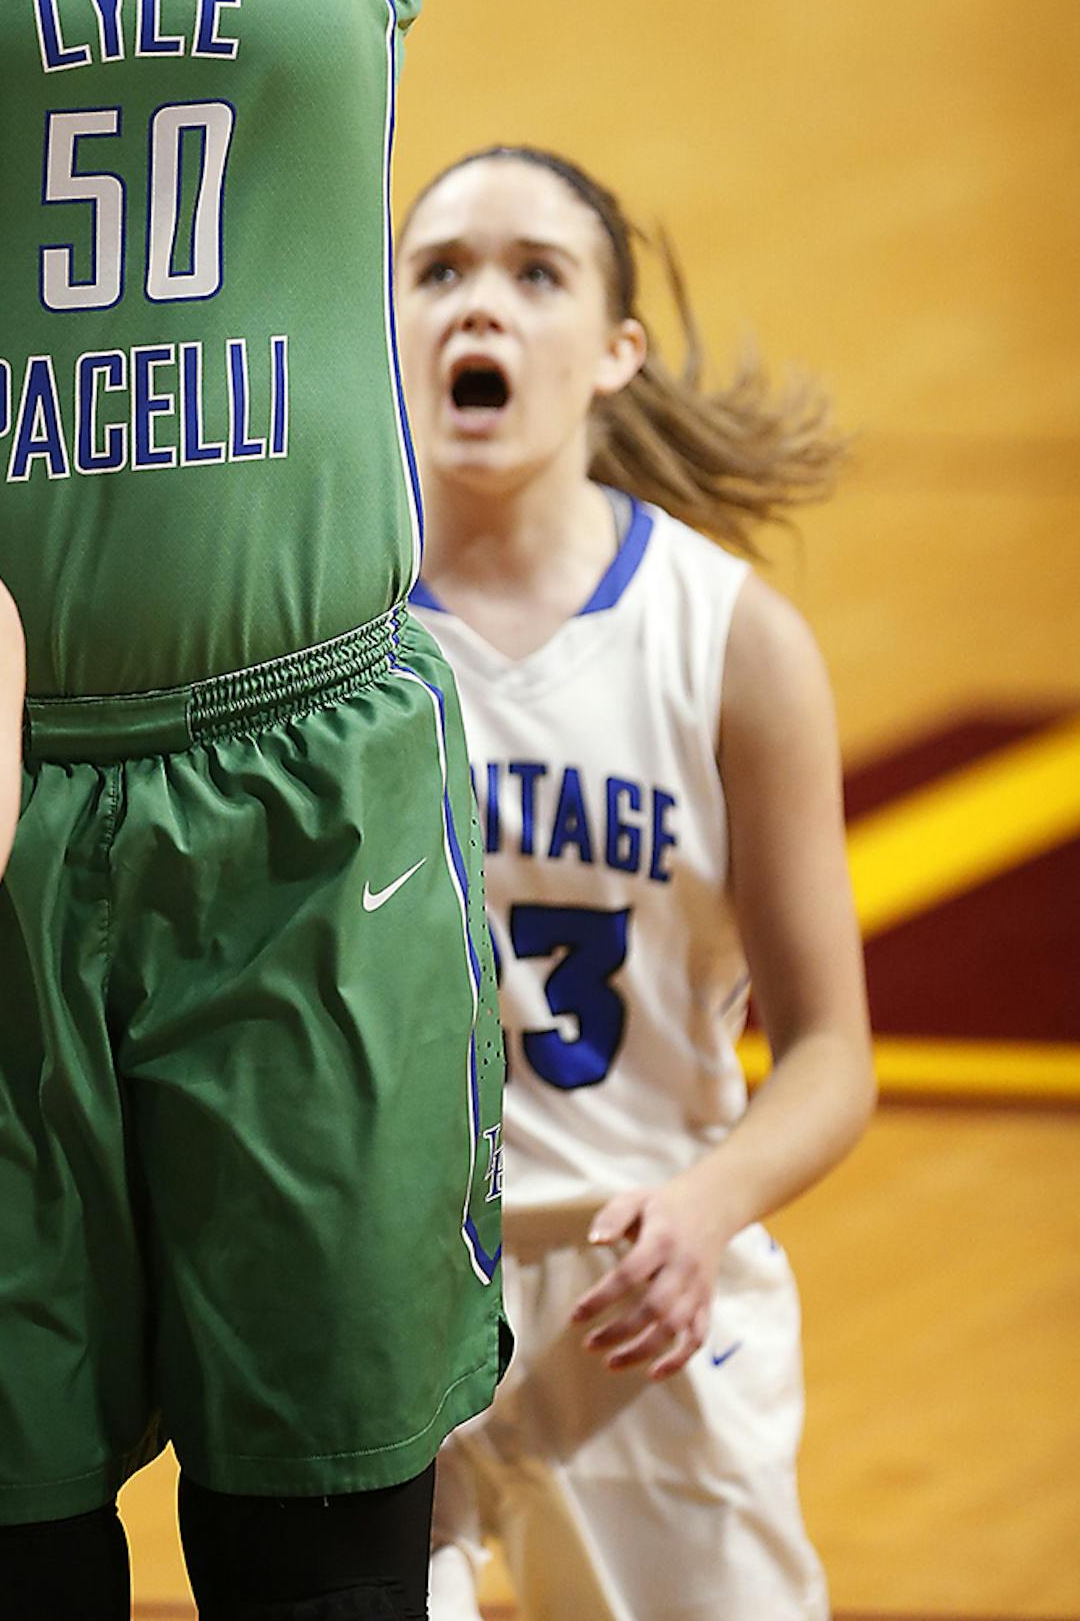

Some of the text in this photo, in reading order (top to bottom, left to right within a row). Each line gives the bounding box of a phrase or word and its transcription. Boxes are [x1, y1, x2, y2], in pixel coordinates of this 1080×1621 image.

[39, 98, 237, 313] 50
[470, 762, 677, 883] ITAGE
[487, 903, 631, 1091] 3
